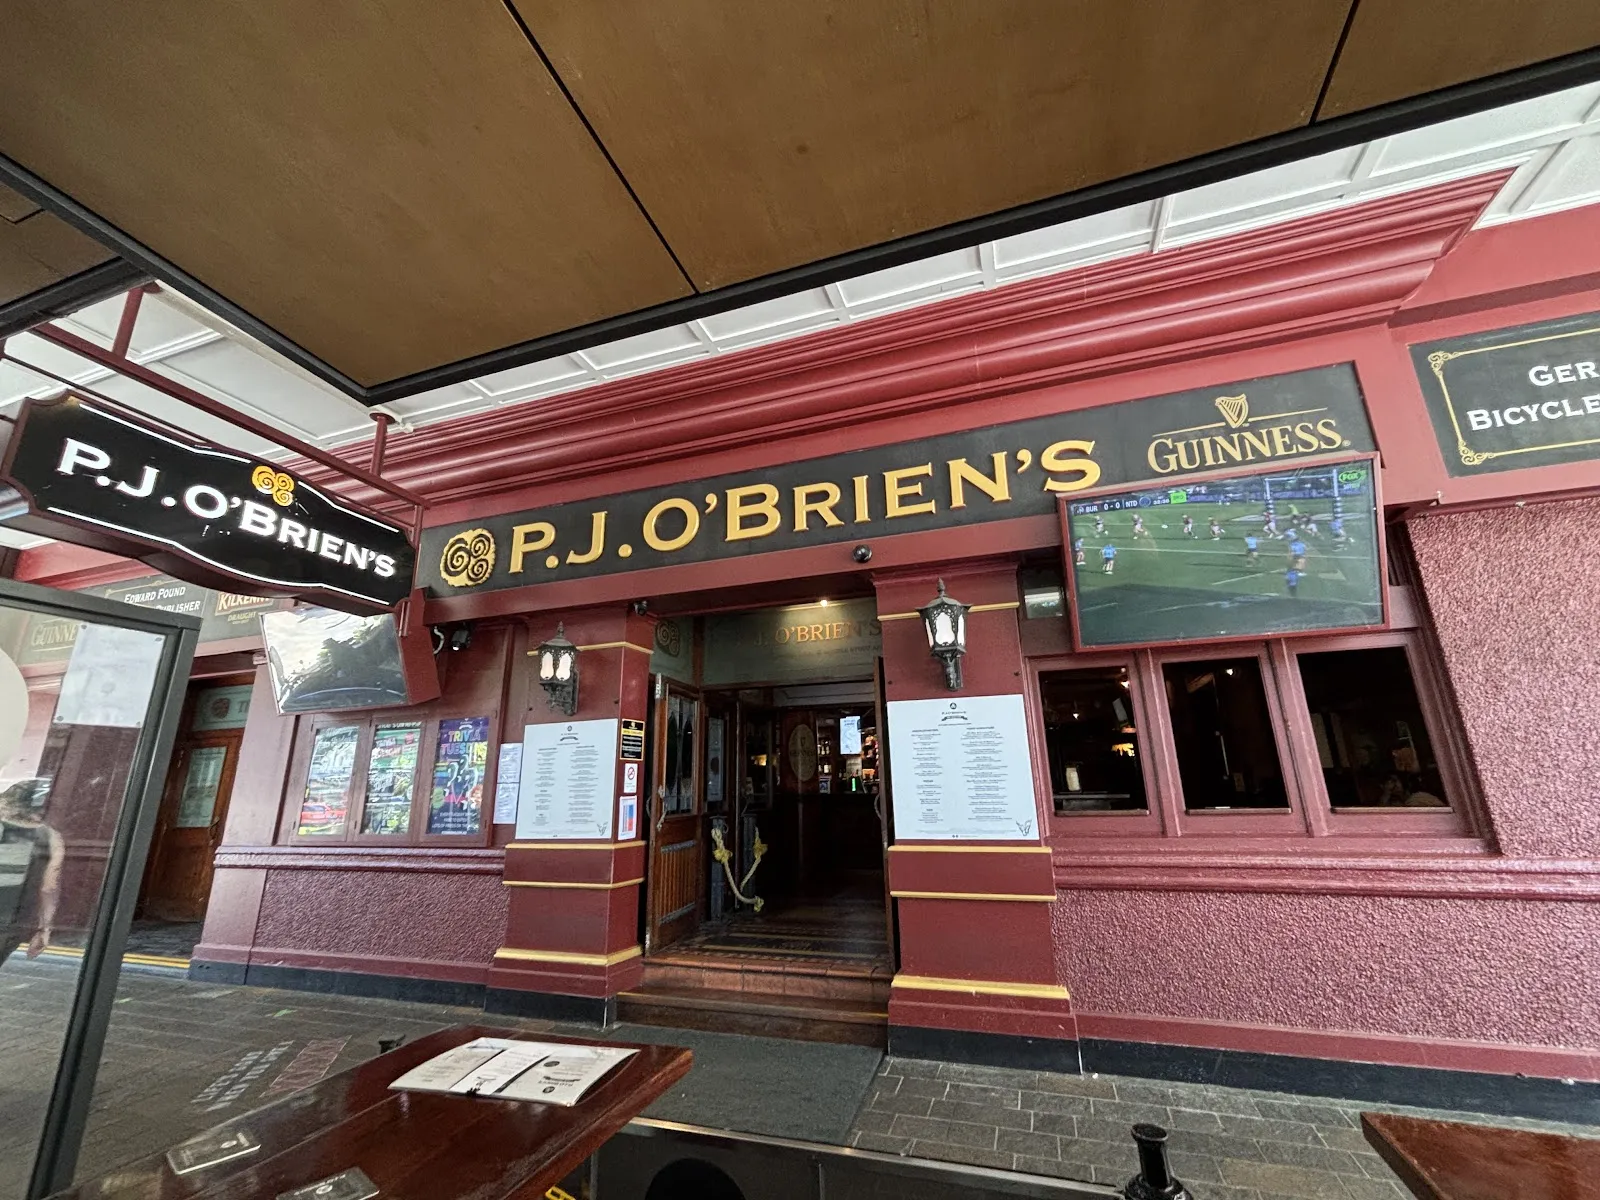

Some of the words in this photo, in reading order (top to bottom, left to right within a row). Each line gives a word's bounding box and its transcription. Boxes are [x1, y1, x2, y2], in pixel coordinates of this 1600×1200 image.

[1147, 419, 1343, 473] GUINNESS
[1085, 505, 1099, 513] BUR
[123, 592, 156, 604] EDWARD
[157, 587, 186, 600] POUND
[31, 623, 78, 647] GUINNE
